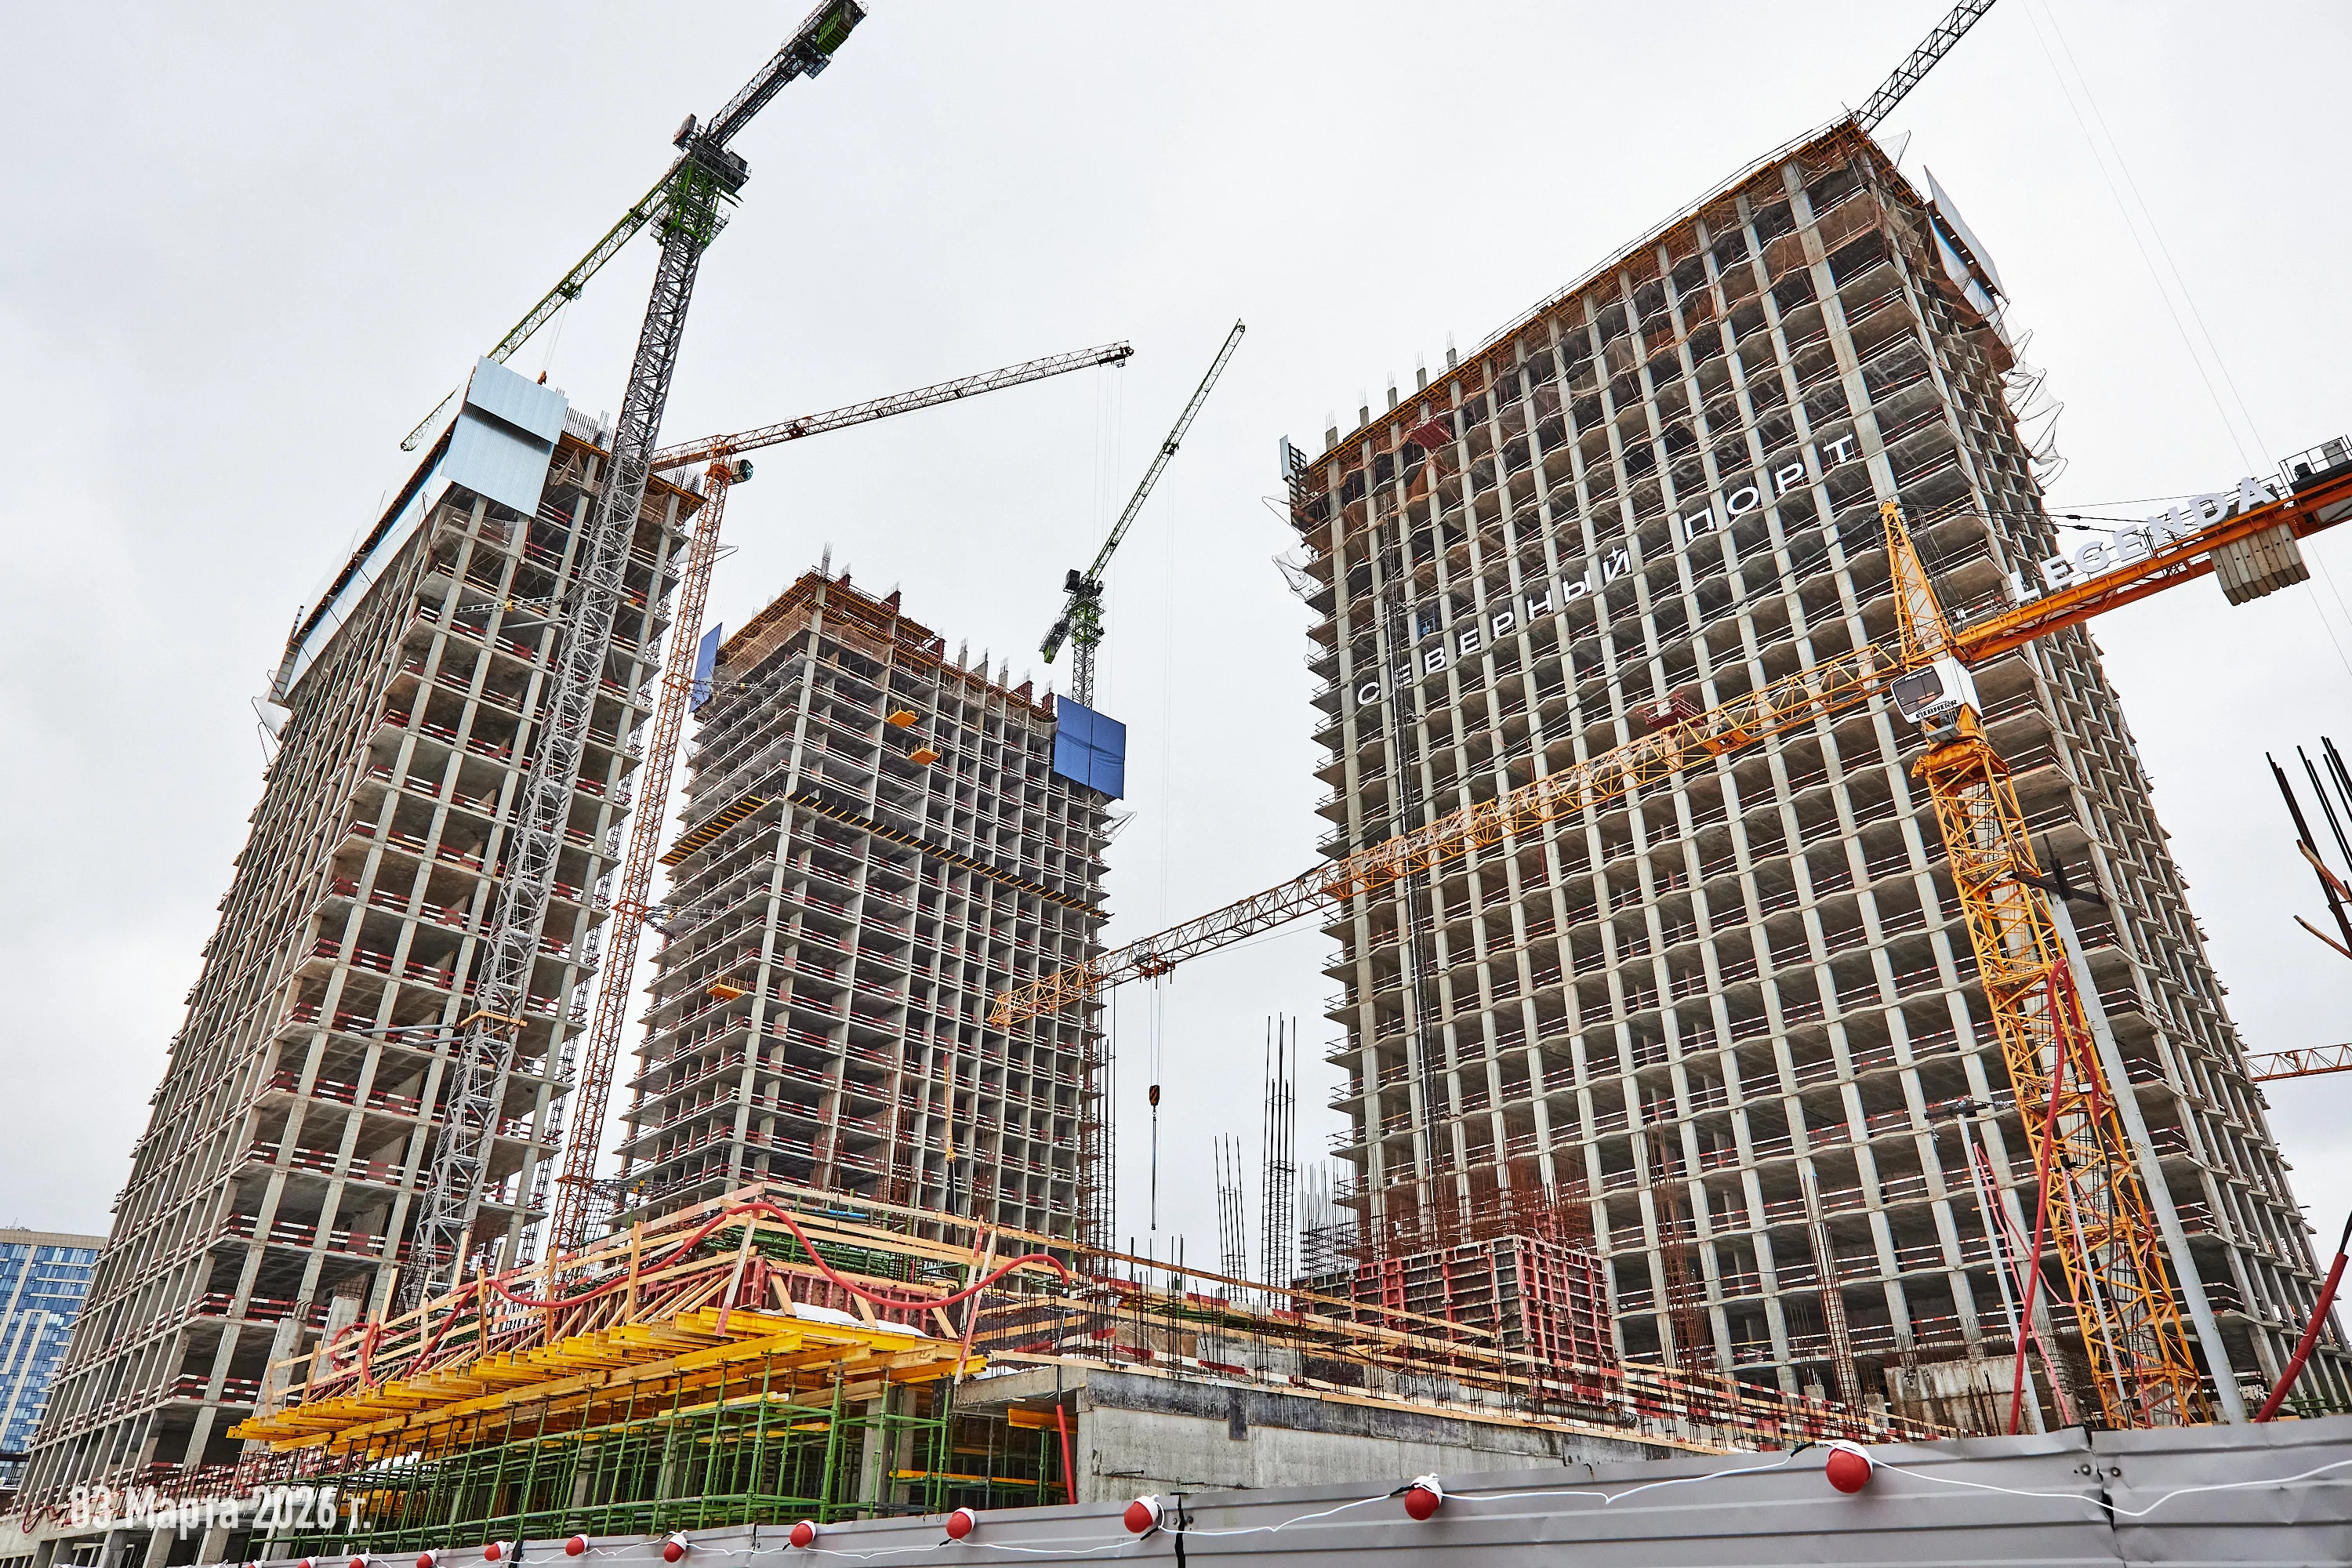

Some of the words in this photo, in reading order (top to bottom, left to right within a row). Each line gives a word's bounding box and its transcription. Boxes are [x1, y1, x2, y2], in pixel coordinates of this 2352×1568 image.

[1357, 546, 1632, 705] СЕВЕРНЫЙ
[1684, 434, 1857, 540] ПОРТ
[2009, 476, 2278, 603] LEGENDA
